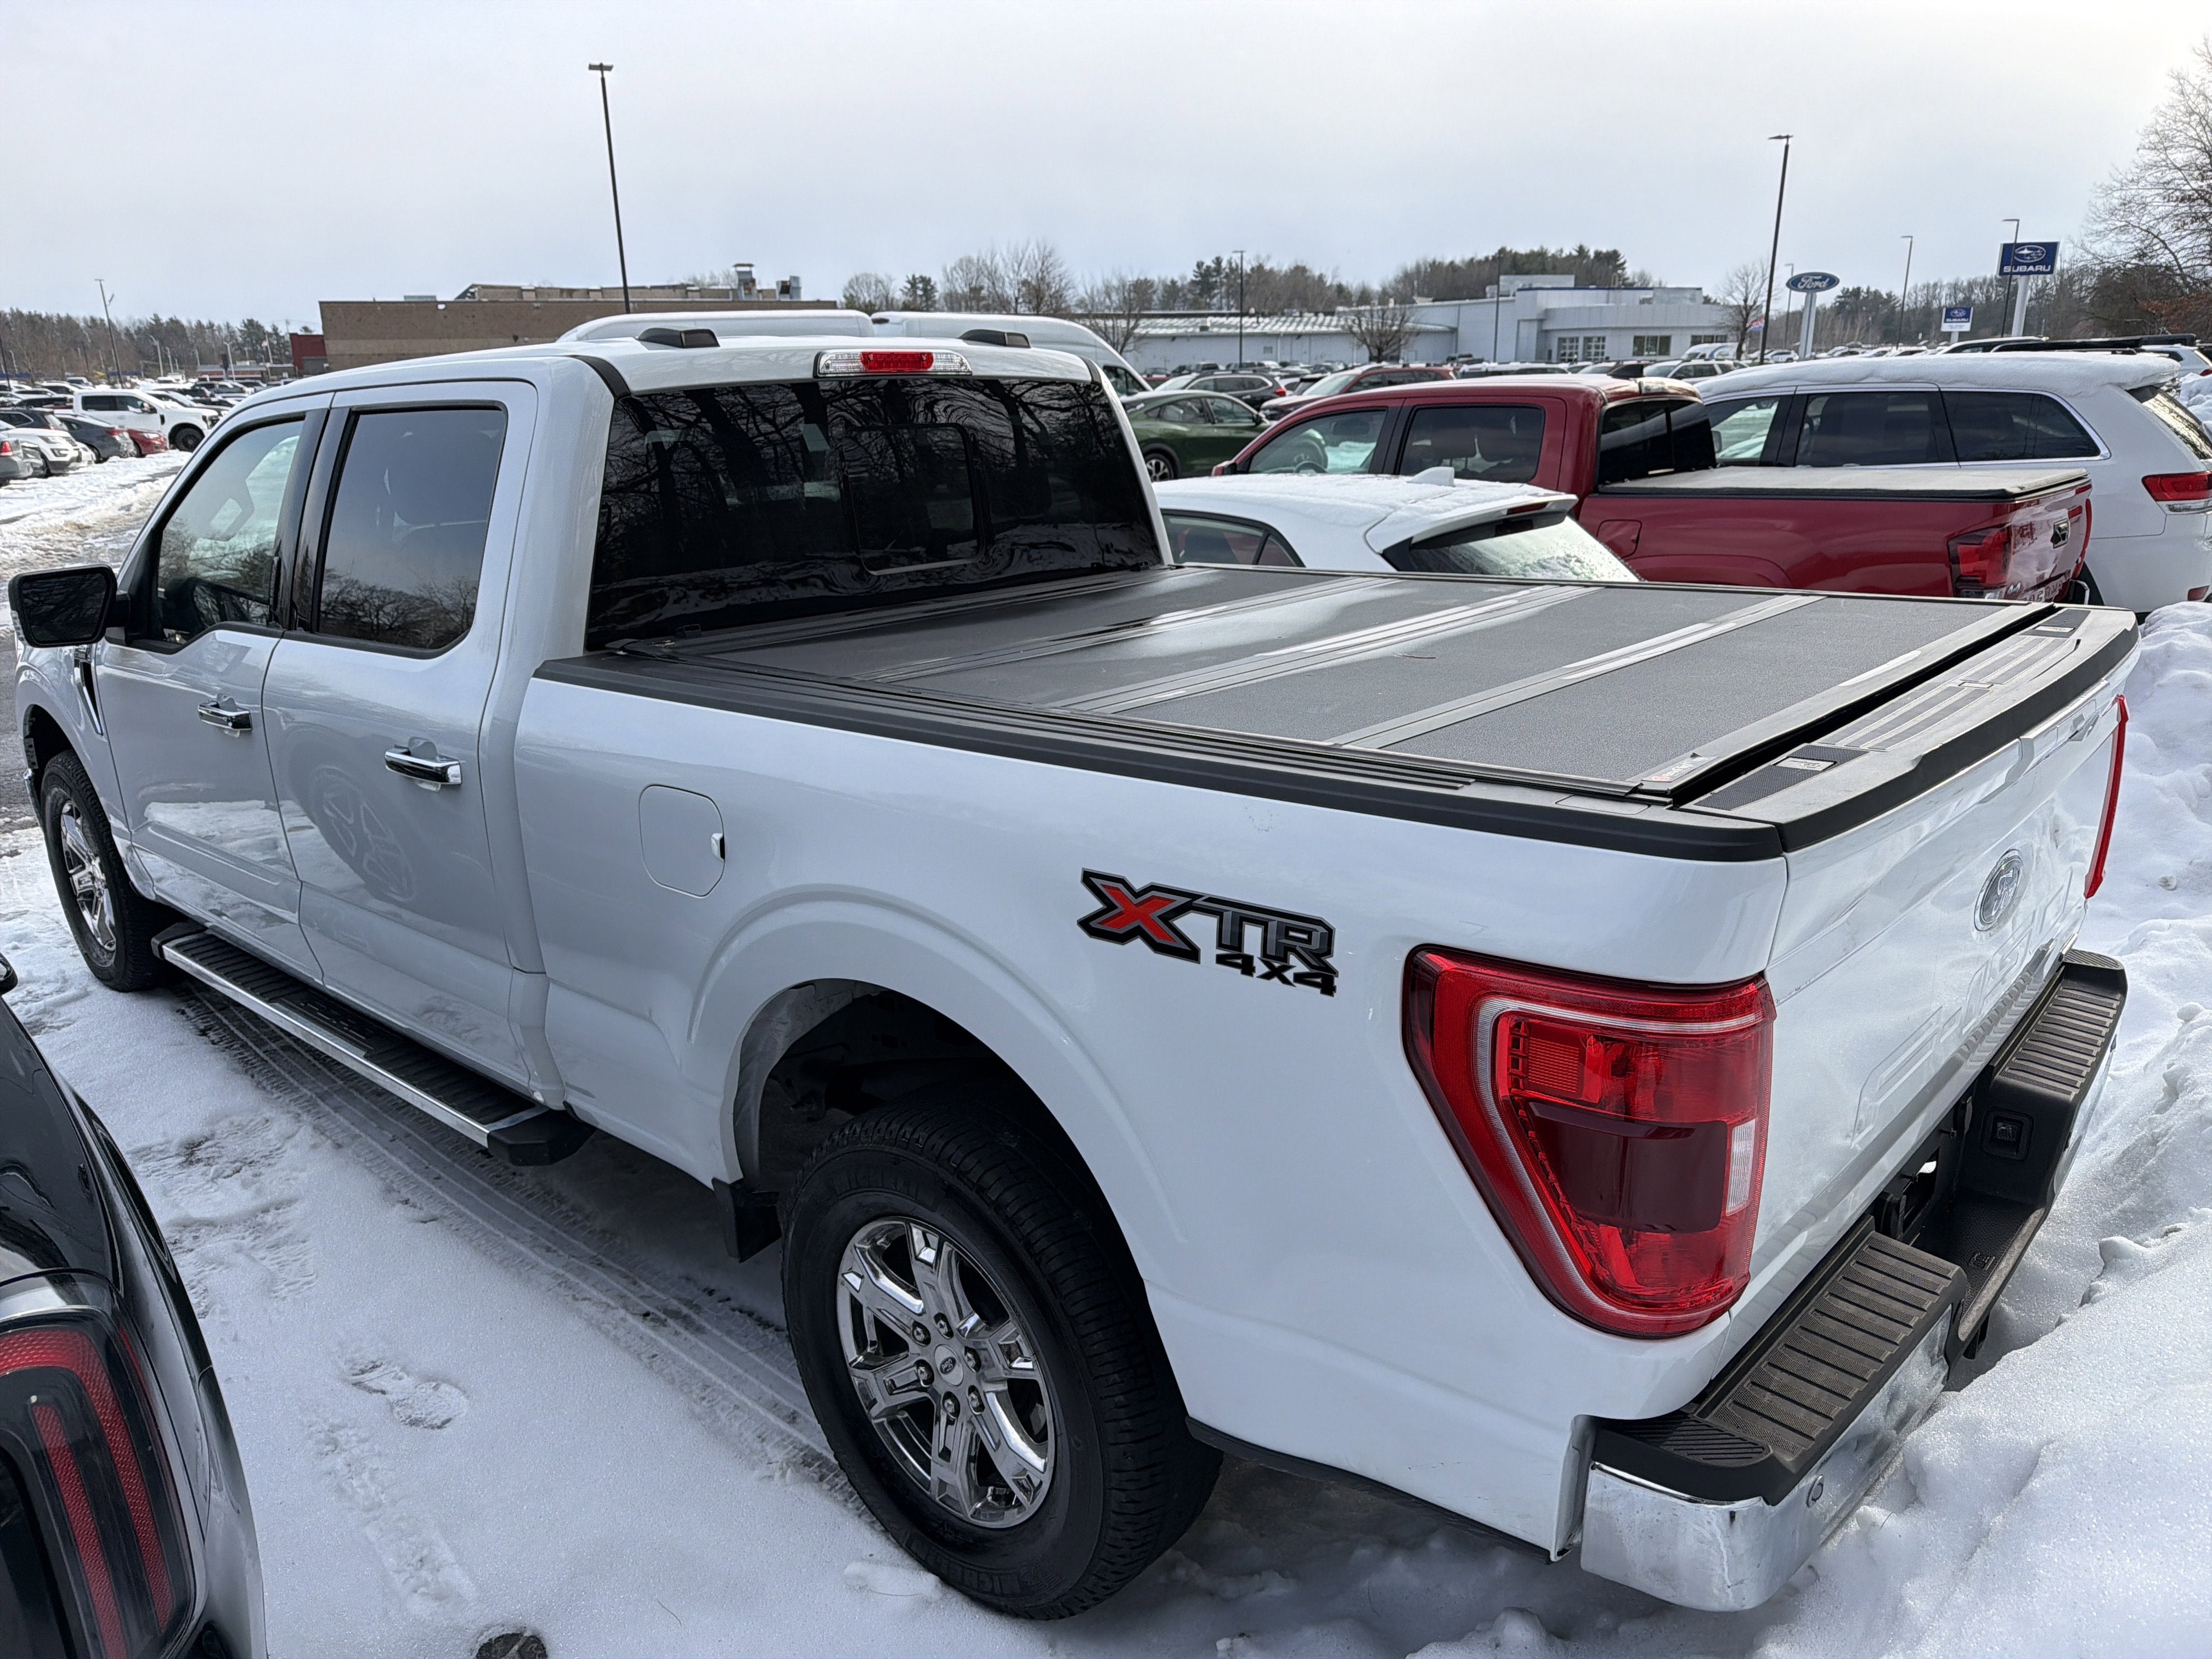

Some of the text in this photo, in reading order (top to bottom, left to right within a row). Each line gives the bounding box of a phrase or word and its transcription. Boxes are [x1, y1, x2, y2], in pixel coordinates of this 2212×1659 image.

[2003, 264, 2051, 273] SUBARU
[1797, 275, 1830, 289] Ford
[1077, 867, 1339, 977] XTR
[941, 1358, 953, 1373] Ford
